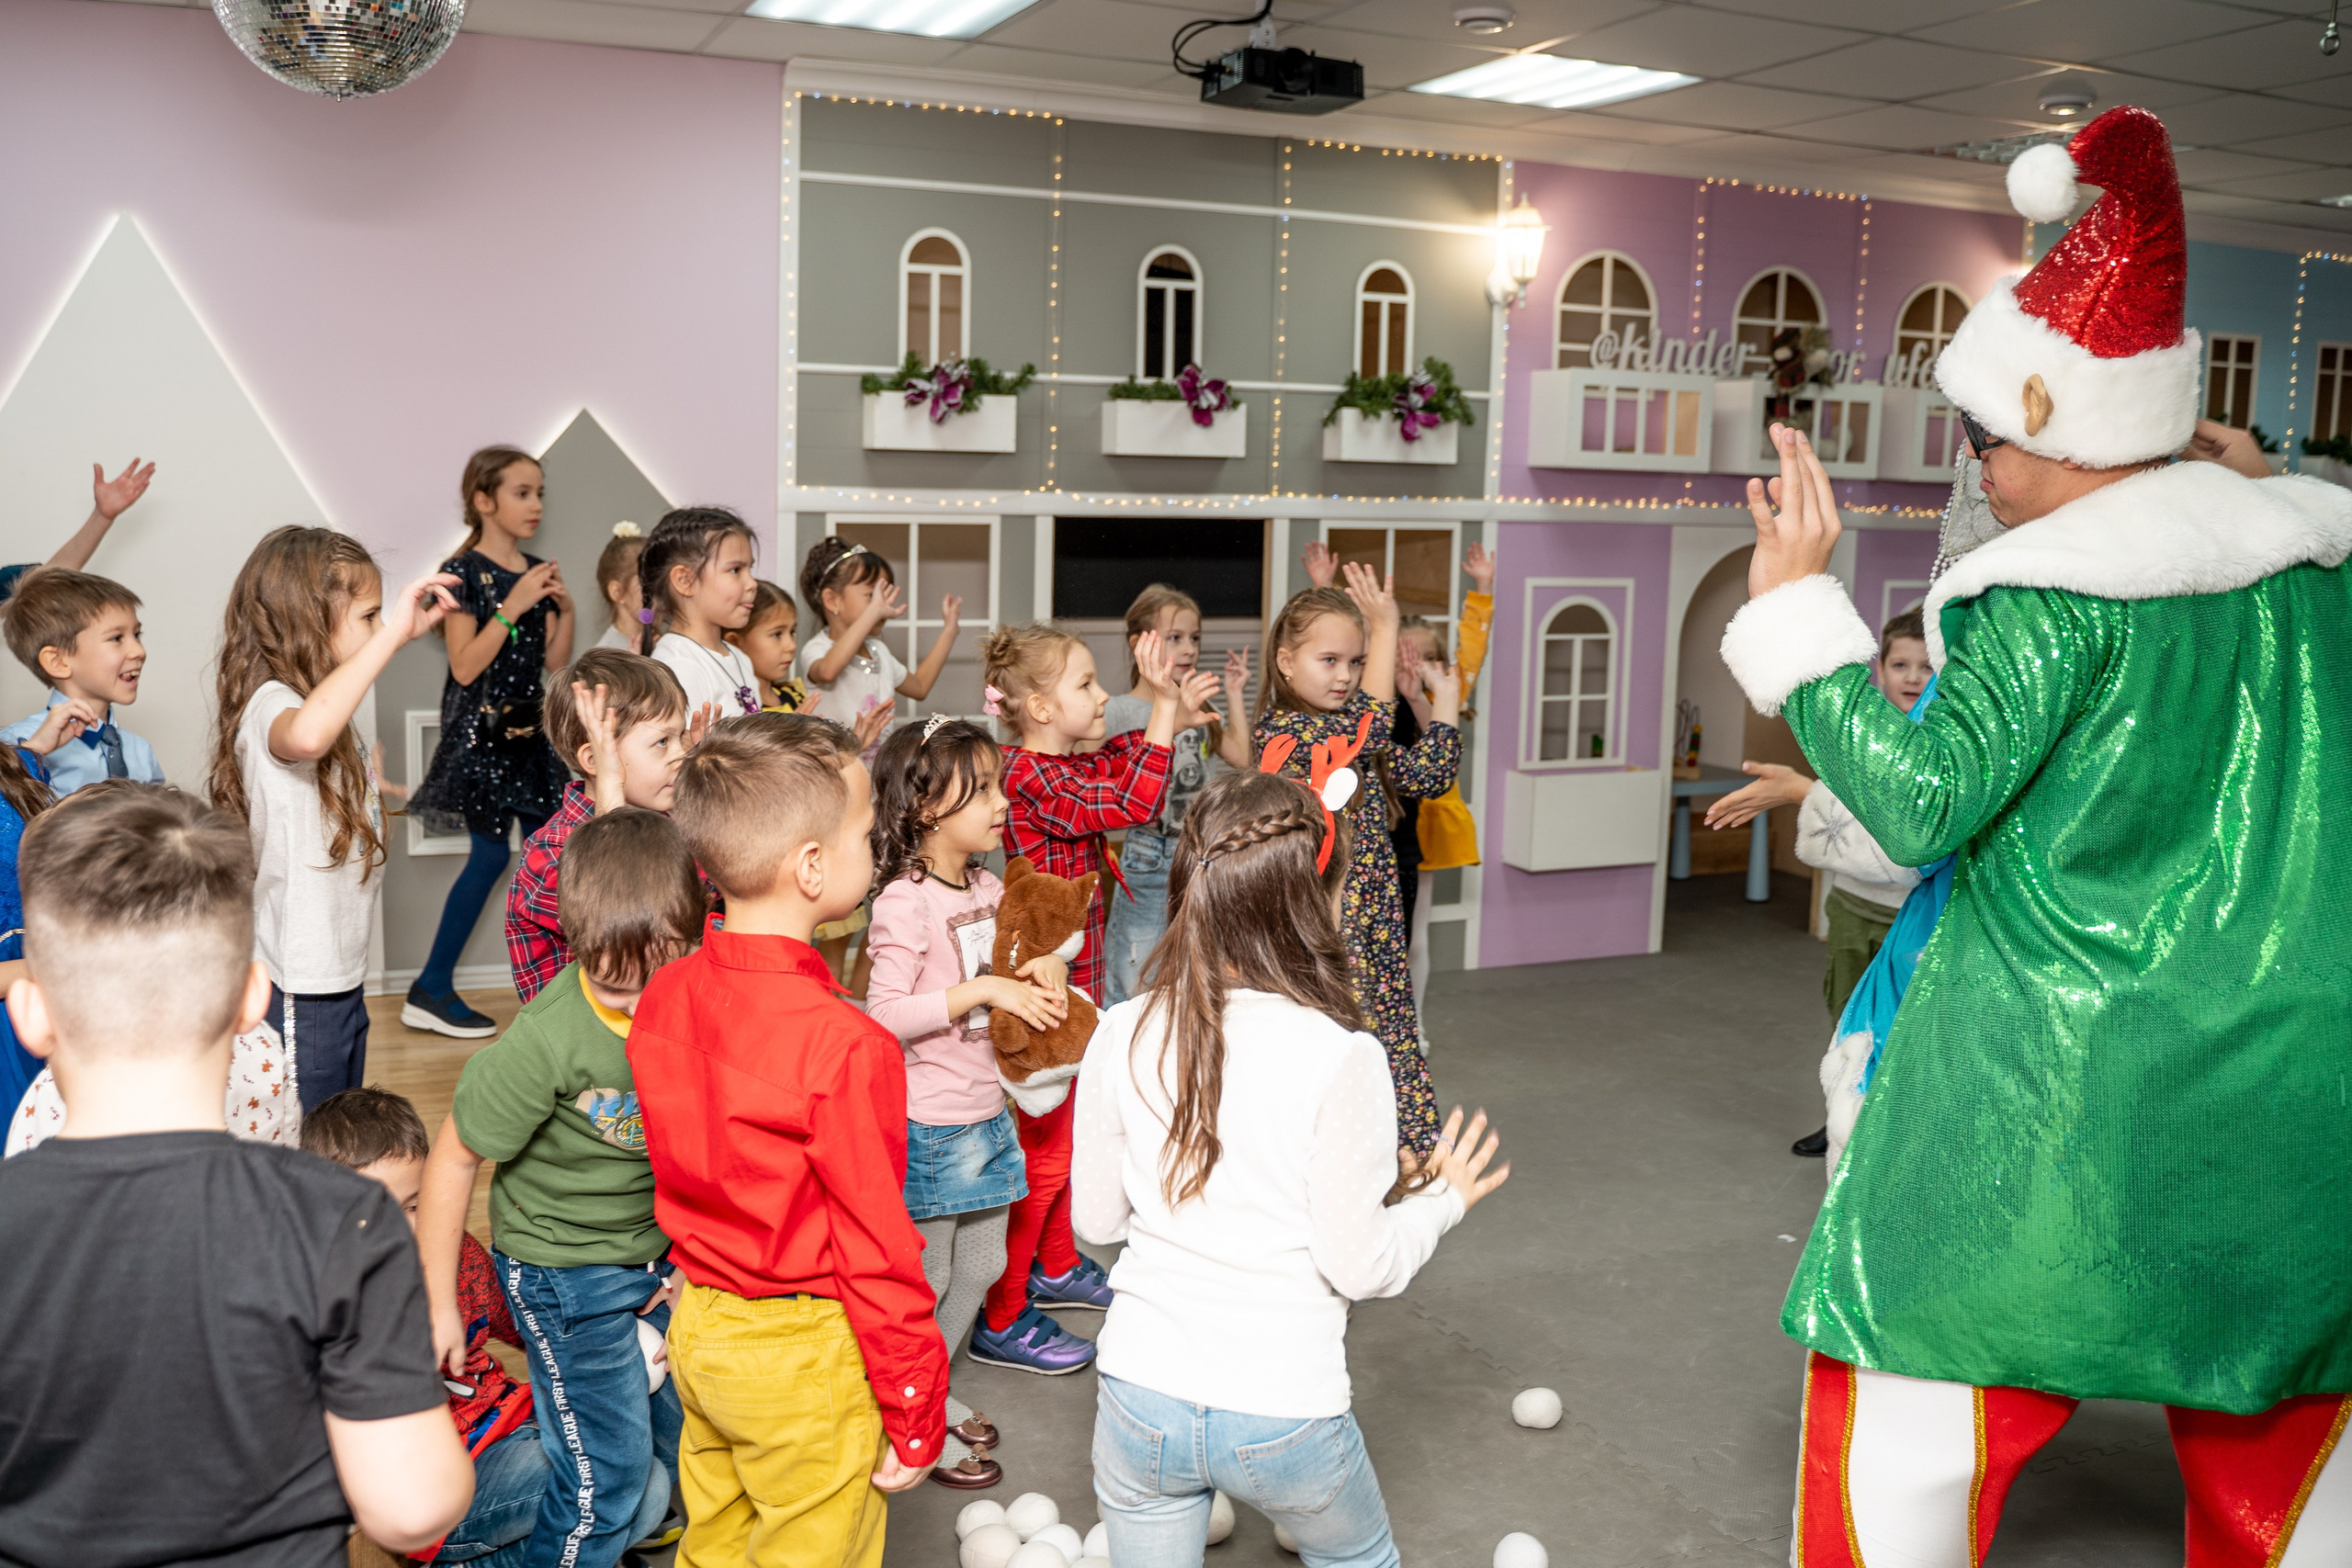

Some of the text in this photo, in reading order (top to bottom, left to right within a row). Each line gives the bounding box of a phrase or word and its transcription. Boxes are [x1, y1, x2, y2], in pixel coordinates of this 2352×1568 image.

[508, 1268, 526, 1308] LEAGUE
[522, 1311, 545, 1337] FIRST
[537, 1337, 561, 1379] LEAGUE
[552, 1381, 570, 1411] FIRST
[560, 1412, 583, 1454] LEAGUE
[576, 1454, 595, 1486] FIRST
